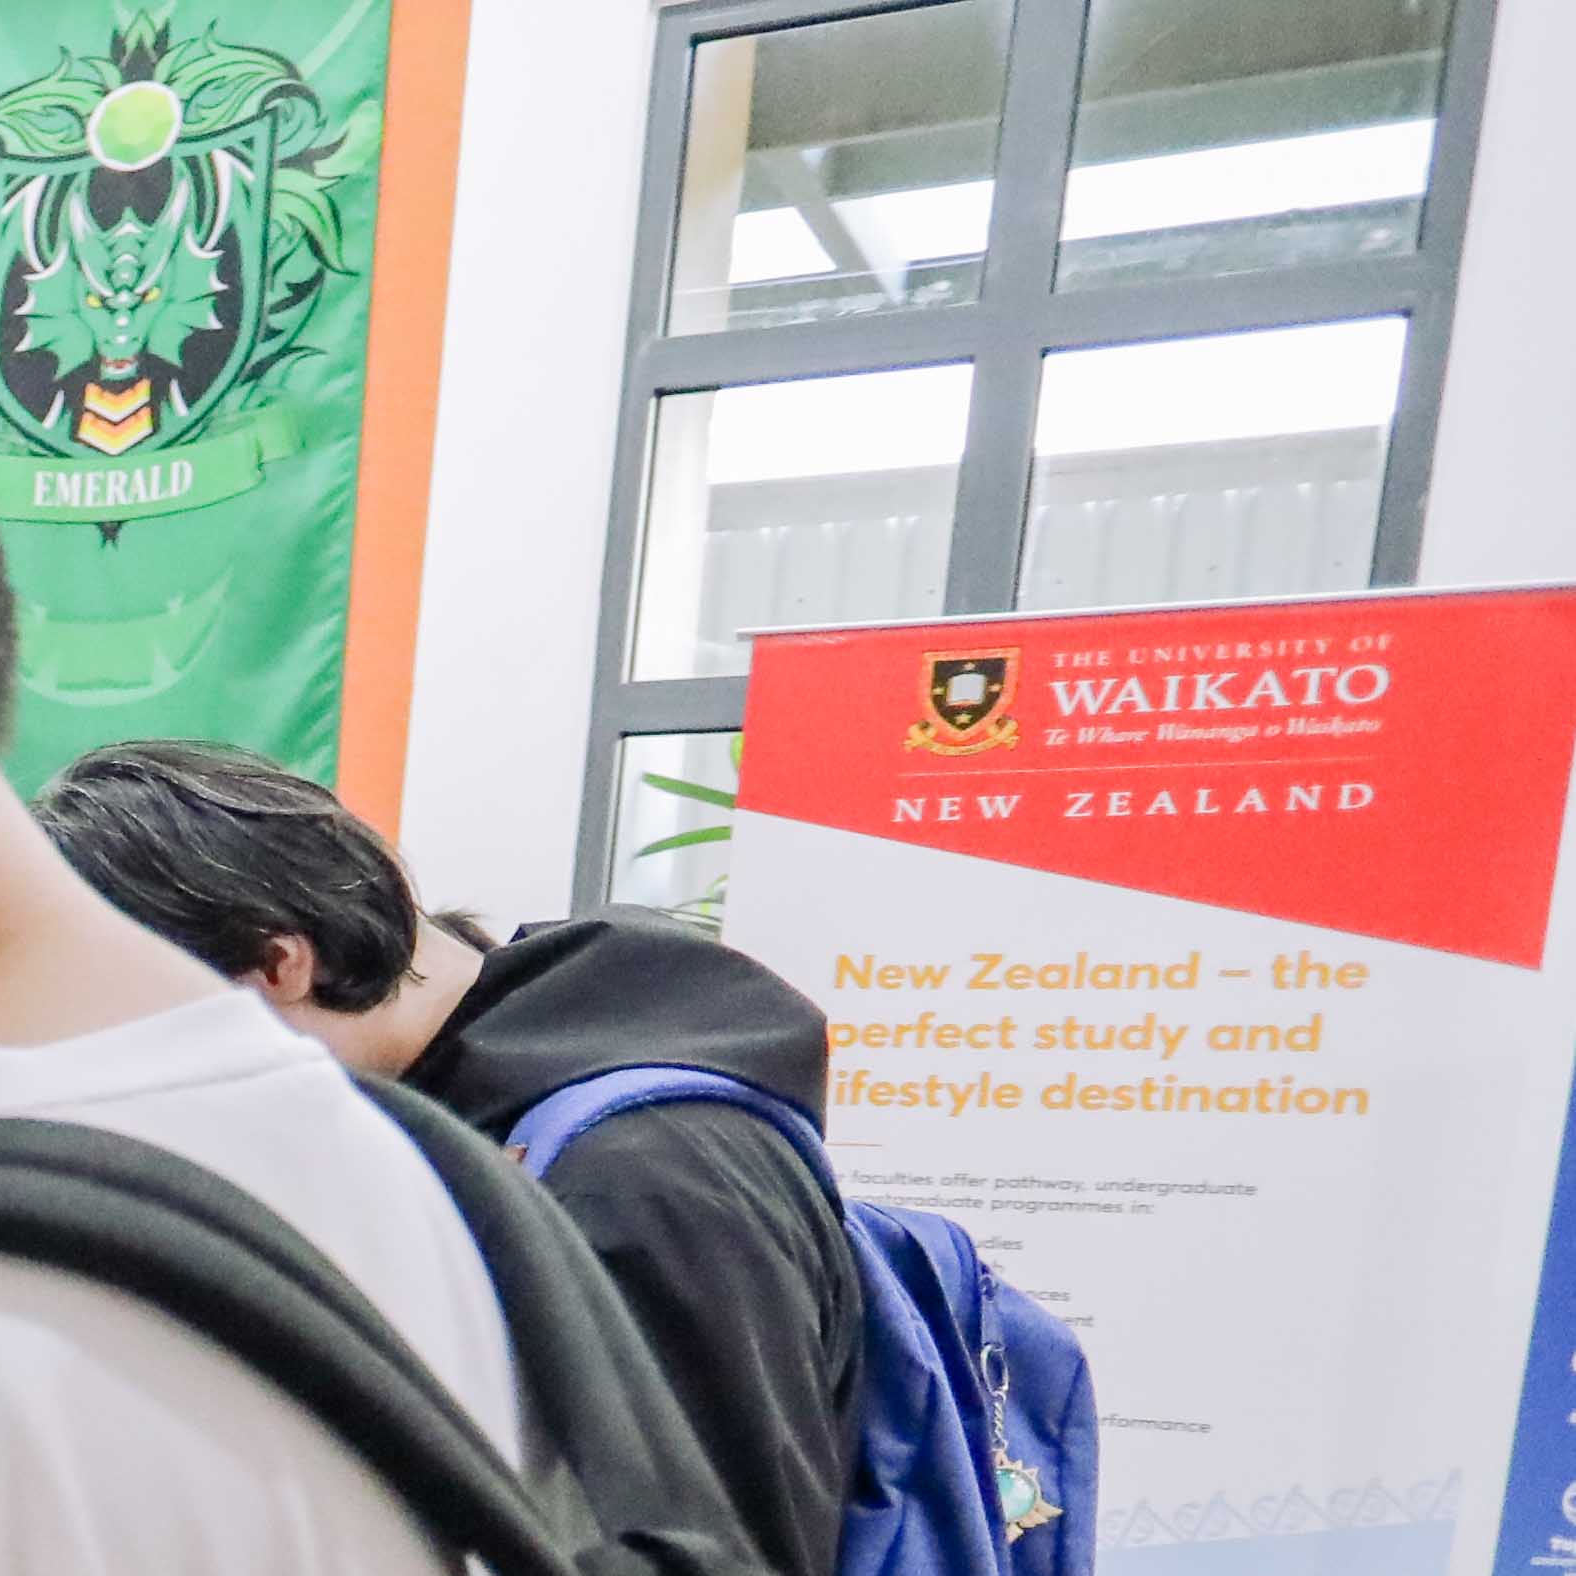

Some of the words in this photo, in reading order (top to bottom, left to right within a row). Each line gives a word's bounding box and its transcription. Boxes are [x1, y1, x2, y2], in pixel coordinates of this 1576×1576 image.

[34, 459, 194, 507] EMERALD
[1051, 651, 1111, 669] THE
[1129, 638, 1330, 666] UNIVERSITY
[1349, 633, 1395, 654] OF
[1049, 663, 1391, 718] WAIKATO
[1043, 728, 1068, 747] Te
[1077, 725, 1149, 745] Whare
[1286, 716, 1383, 738] Waikato
[891, 794, 1022, 823] NEW
[1063, 783, 1375, 819] ZEALAND
[833, 953, 951, 991] New
[966, 951, 1201, 991] Zealand
[1270, 950, 1370, 991] the
[828, 1011, 1019, 1057] perfect
[1033, 1014, 1189, 1060] study
[1206, 1013, 1324, 1054] and
[1039, 1074, 1370, 1115] destination
[852, 1170, 934, 1187] faculties
[940, 1173, 989, 1188] offer
[1094, 1179, 1259, 1197] undergraduate
[991, 1198, 1124, 1216] programmes
